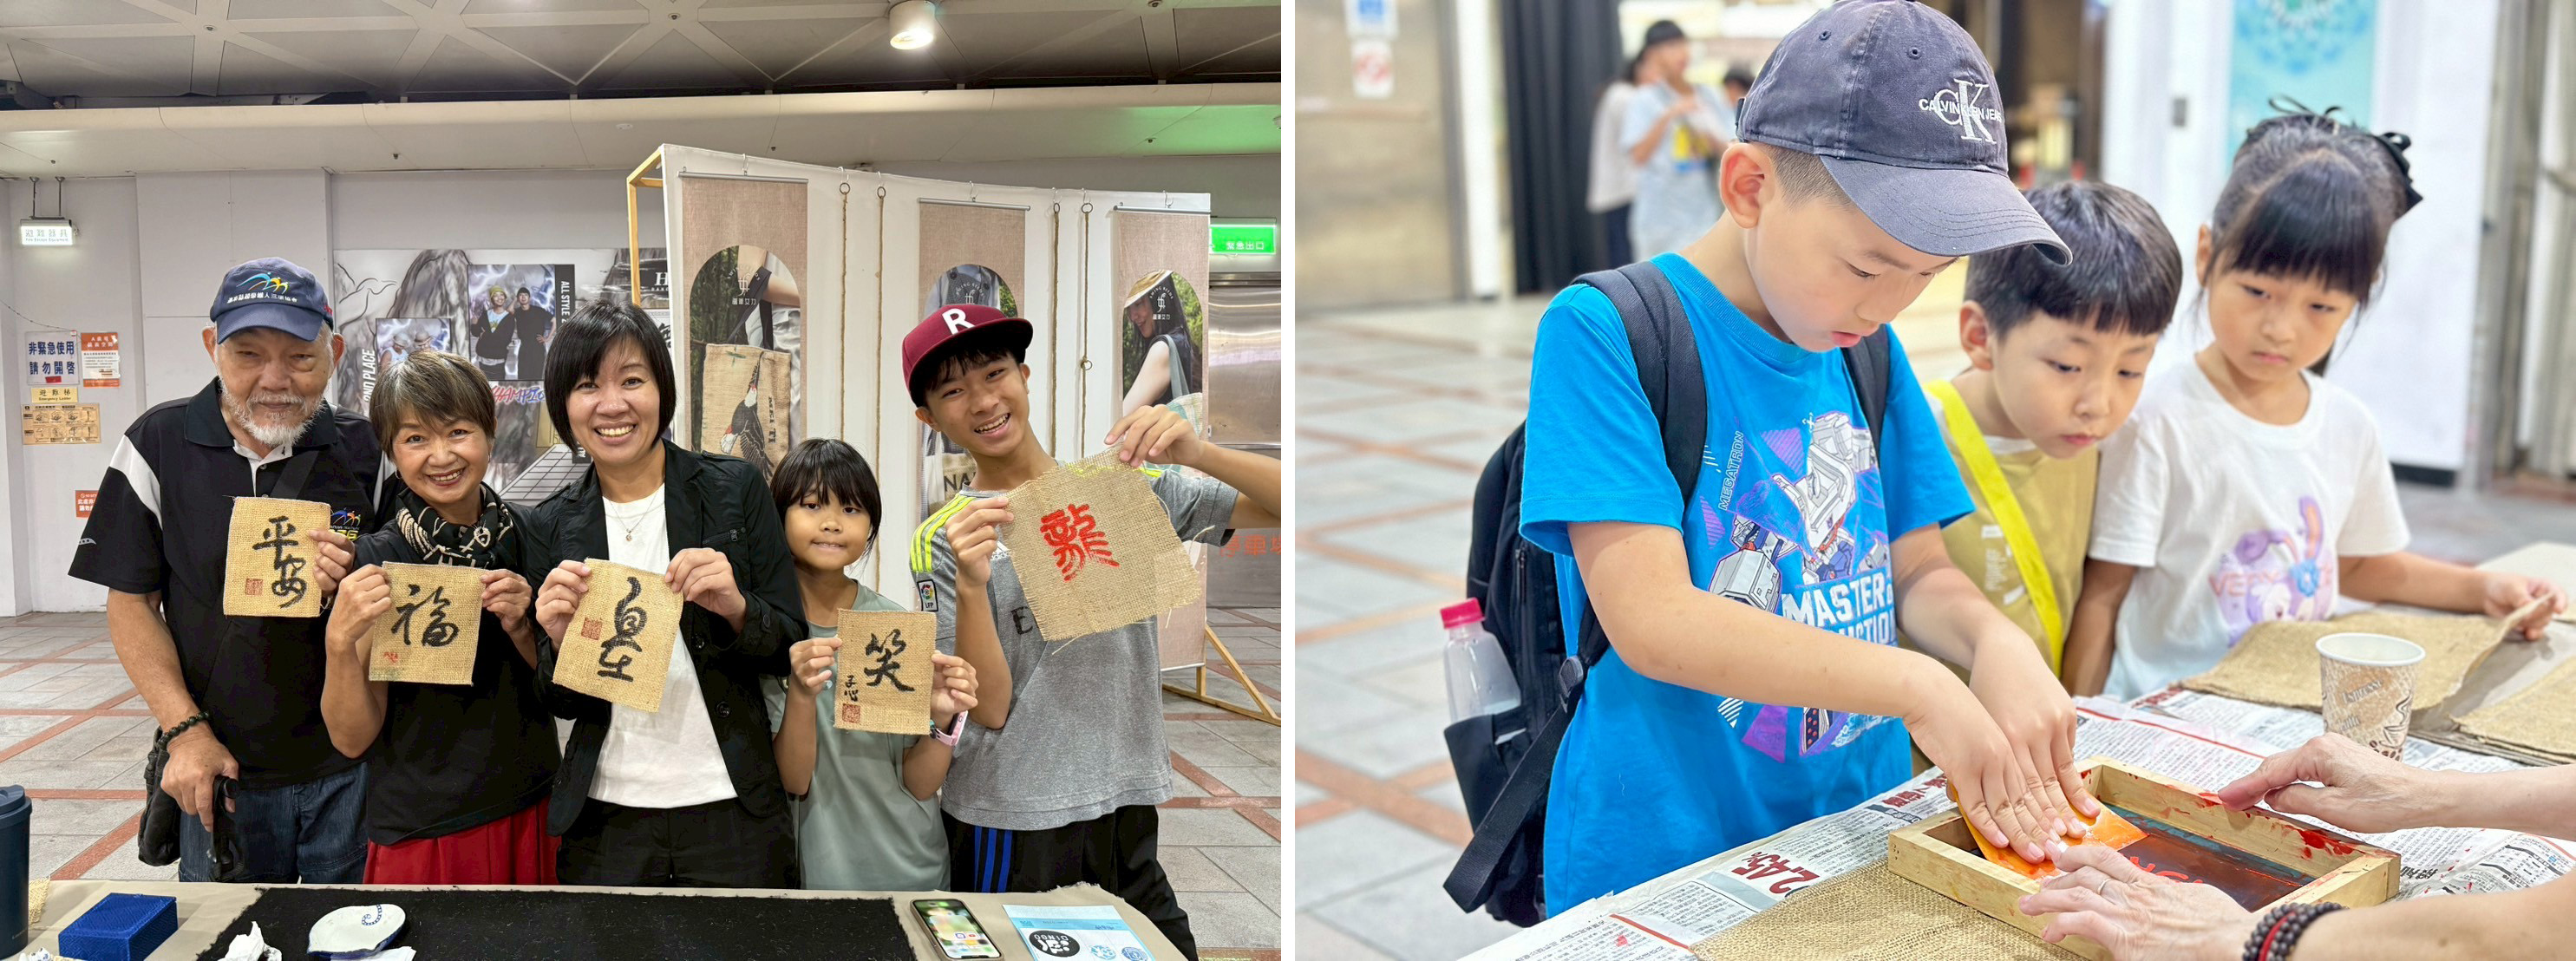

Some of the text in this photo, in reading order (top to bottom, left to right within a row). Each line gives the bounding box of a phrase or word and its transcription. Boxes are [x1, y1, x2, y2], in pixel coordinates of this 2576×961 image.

[1919, 98, 1960, 114] CALVIN
[1226, 241, 1264, 250] 緊急出口
[561, 281, 570, 293] ALL
[561, 295, 570, 316] STYLE
[941, 307, 976, 335] R
[29, 341, 75, 356] 非緊急使用
[362, 349, 376, 381] PLACE
[1718, 431, 1745, 510] MEGATRON
[1040, 503, 1120, 582] 龍
[252, 515, 307, 609] 平安
[1782, 572, 1886, 628] MASTER
[390, 584, 461, 647] 福
[864, 629, 915, 692] 笑
[1034, 933, 1069, 942] DINGO
